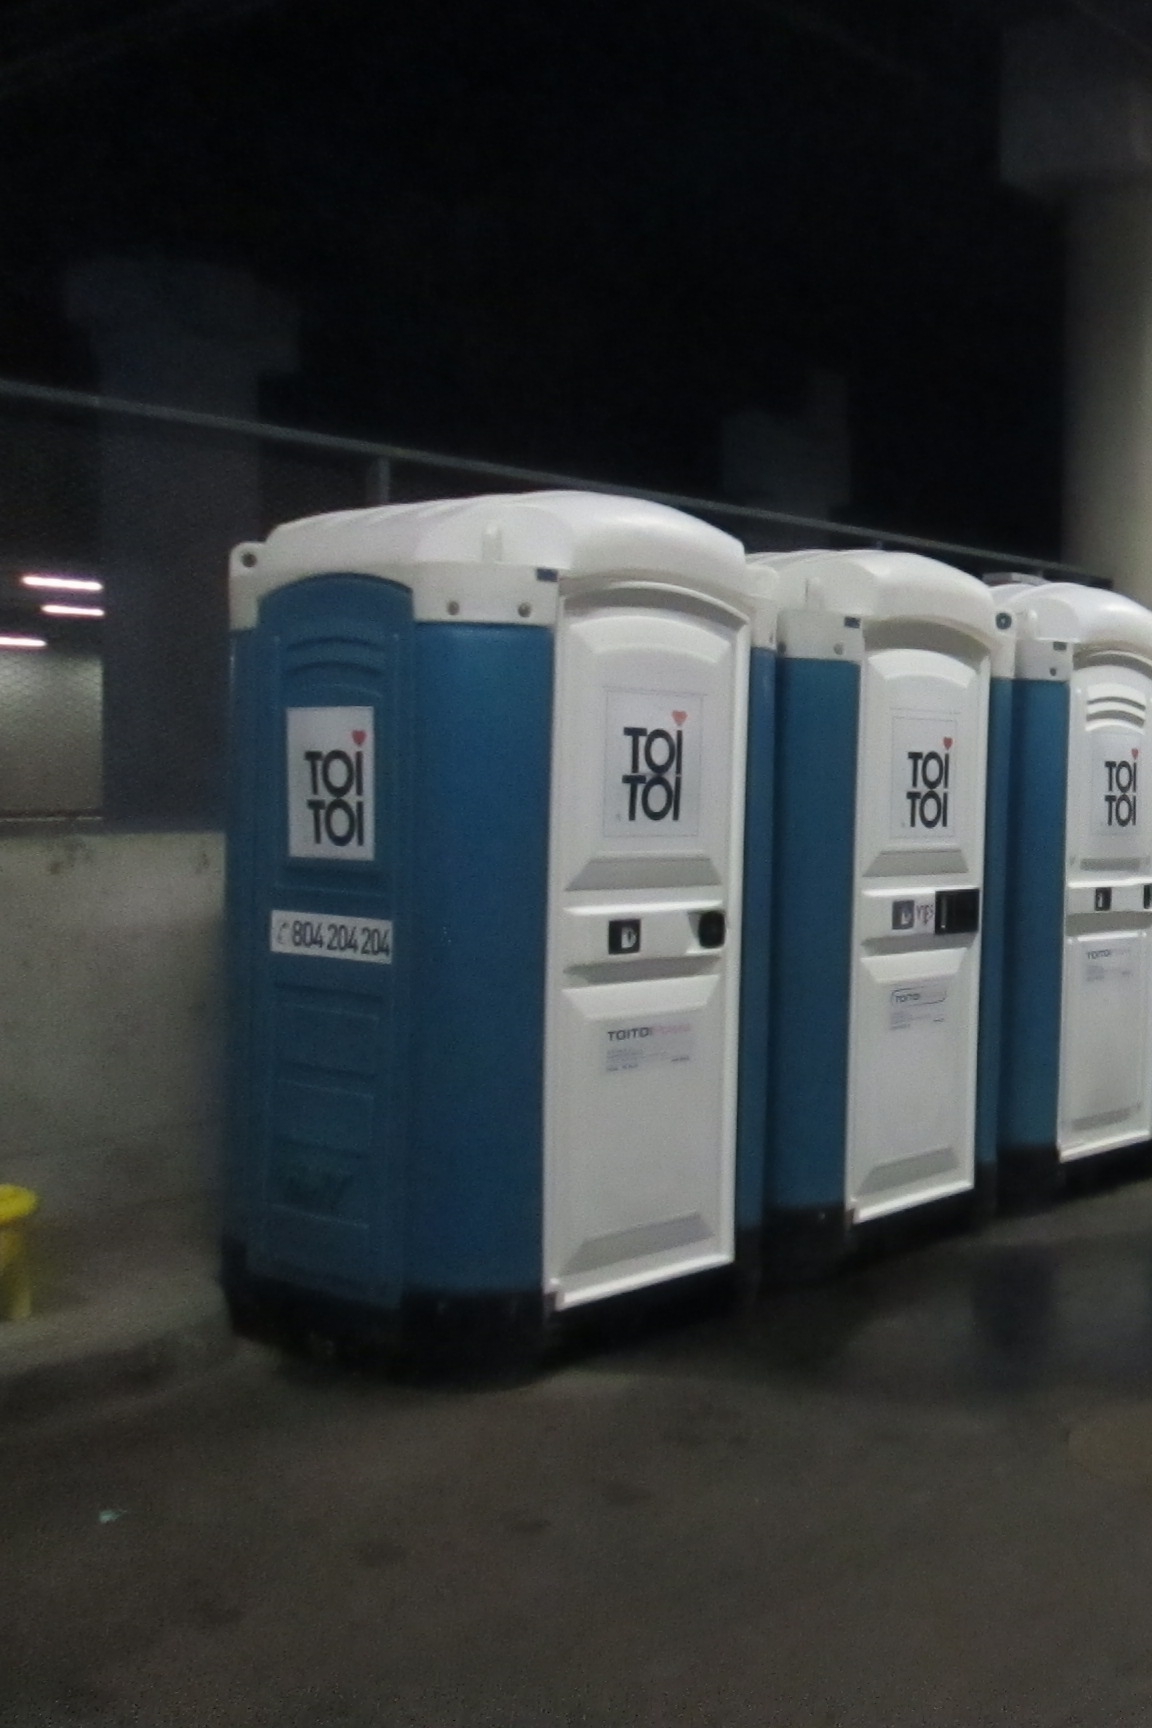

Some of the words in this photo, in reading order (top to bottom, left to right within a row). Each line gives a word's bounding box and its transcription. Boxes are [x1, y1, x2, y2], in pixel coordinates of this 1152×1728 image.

[621, 775, 682, 821] TOI
[906, 790, 948, 828] TOI
[1104, 794, 1136, 827] TOI
[307, 799, 364, 846] TOI
[292, 920, 324, 948] 804
[327, 923, 358, 953] 204
[360, 927, 390, 956] 204
